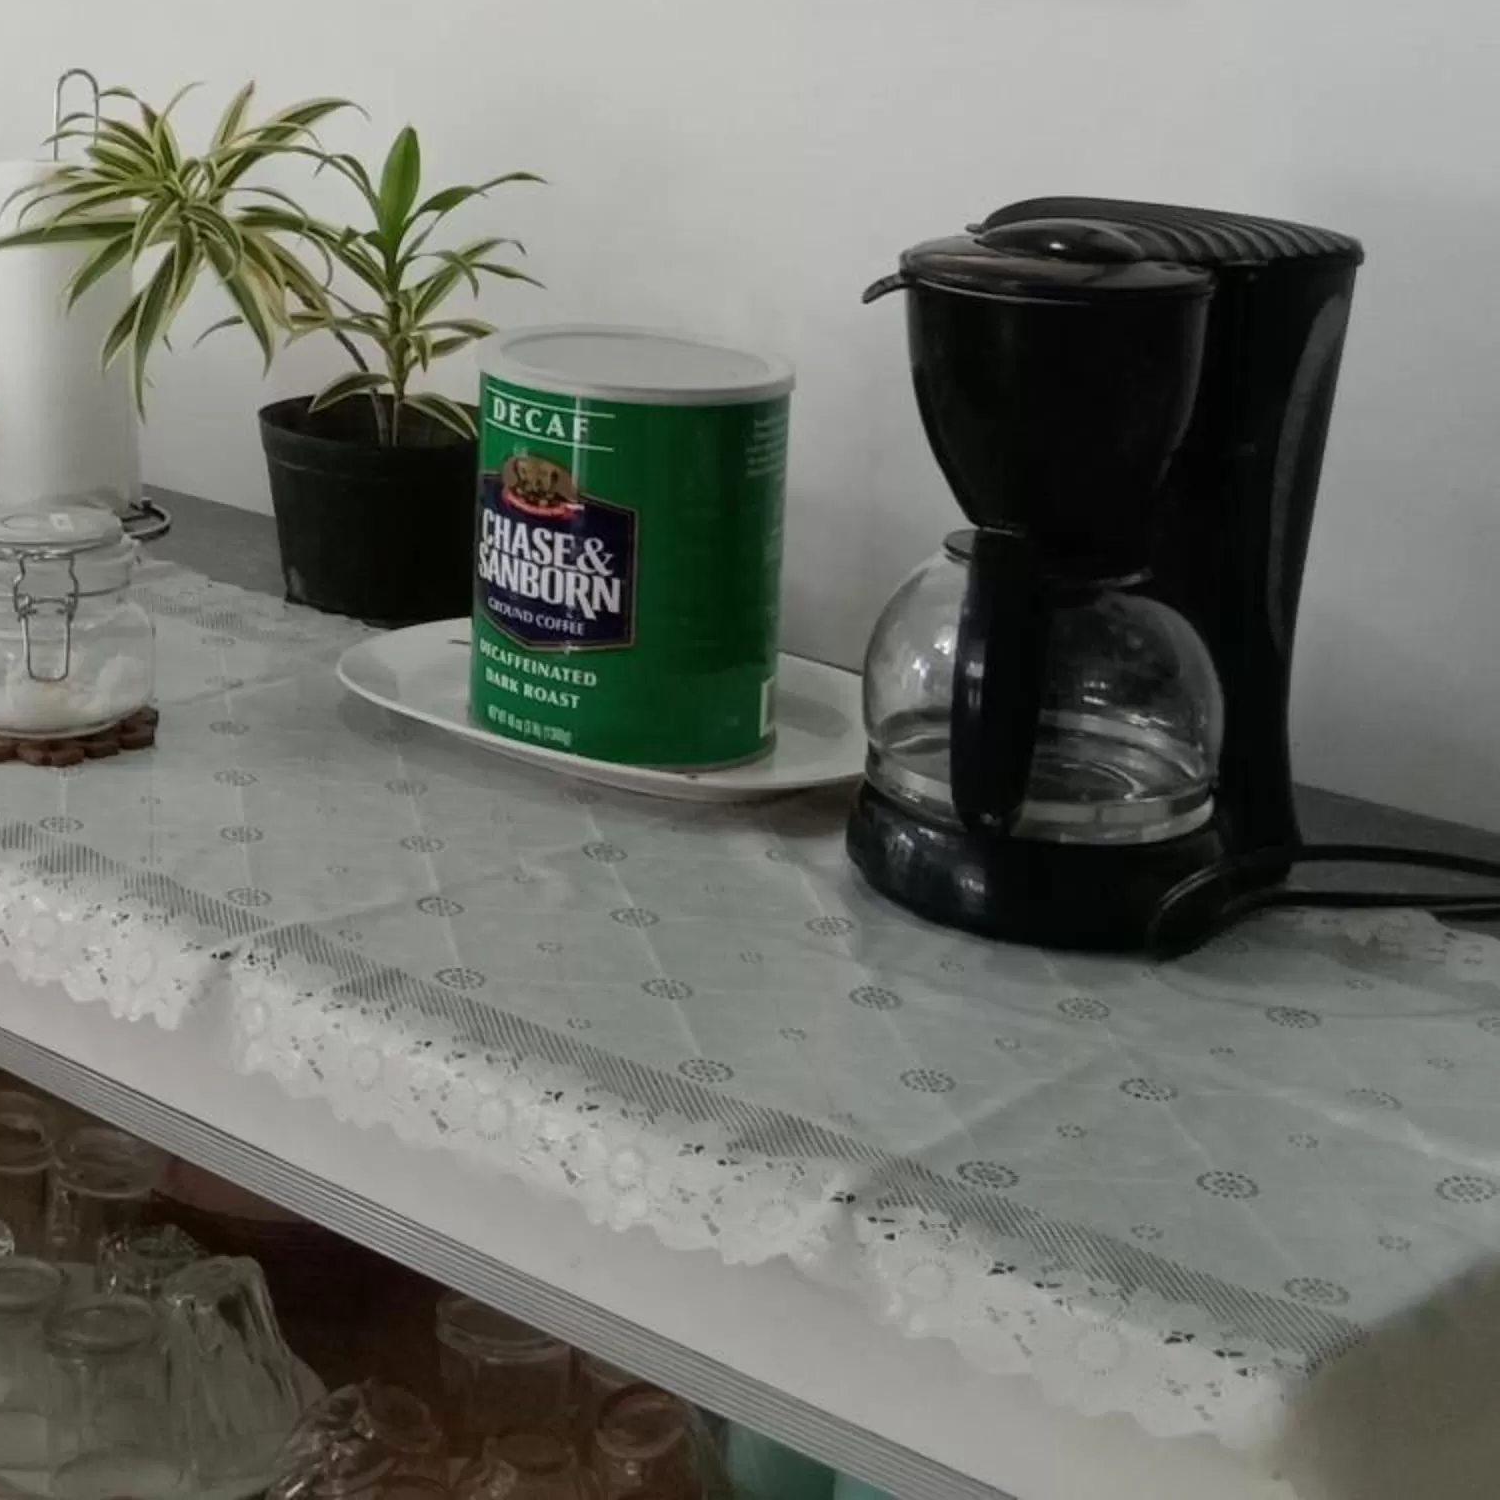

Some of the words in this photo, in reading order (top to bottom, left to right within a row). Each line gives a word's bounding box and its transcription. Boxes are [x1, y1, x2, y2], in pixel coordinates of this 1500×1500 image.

[493, 396, 589, 441] DECAF
[479, 541, 621, 620] SANBORN
[487, 596, 534, 623] GROUND
[535, 613, 585, 636] COFFEE
[480, 637, 597, 687] DECAFFEINATED
[485, 666, 519, 694] DARK
[523, 683, 580, 709] ROAST
